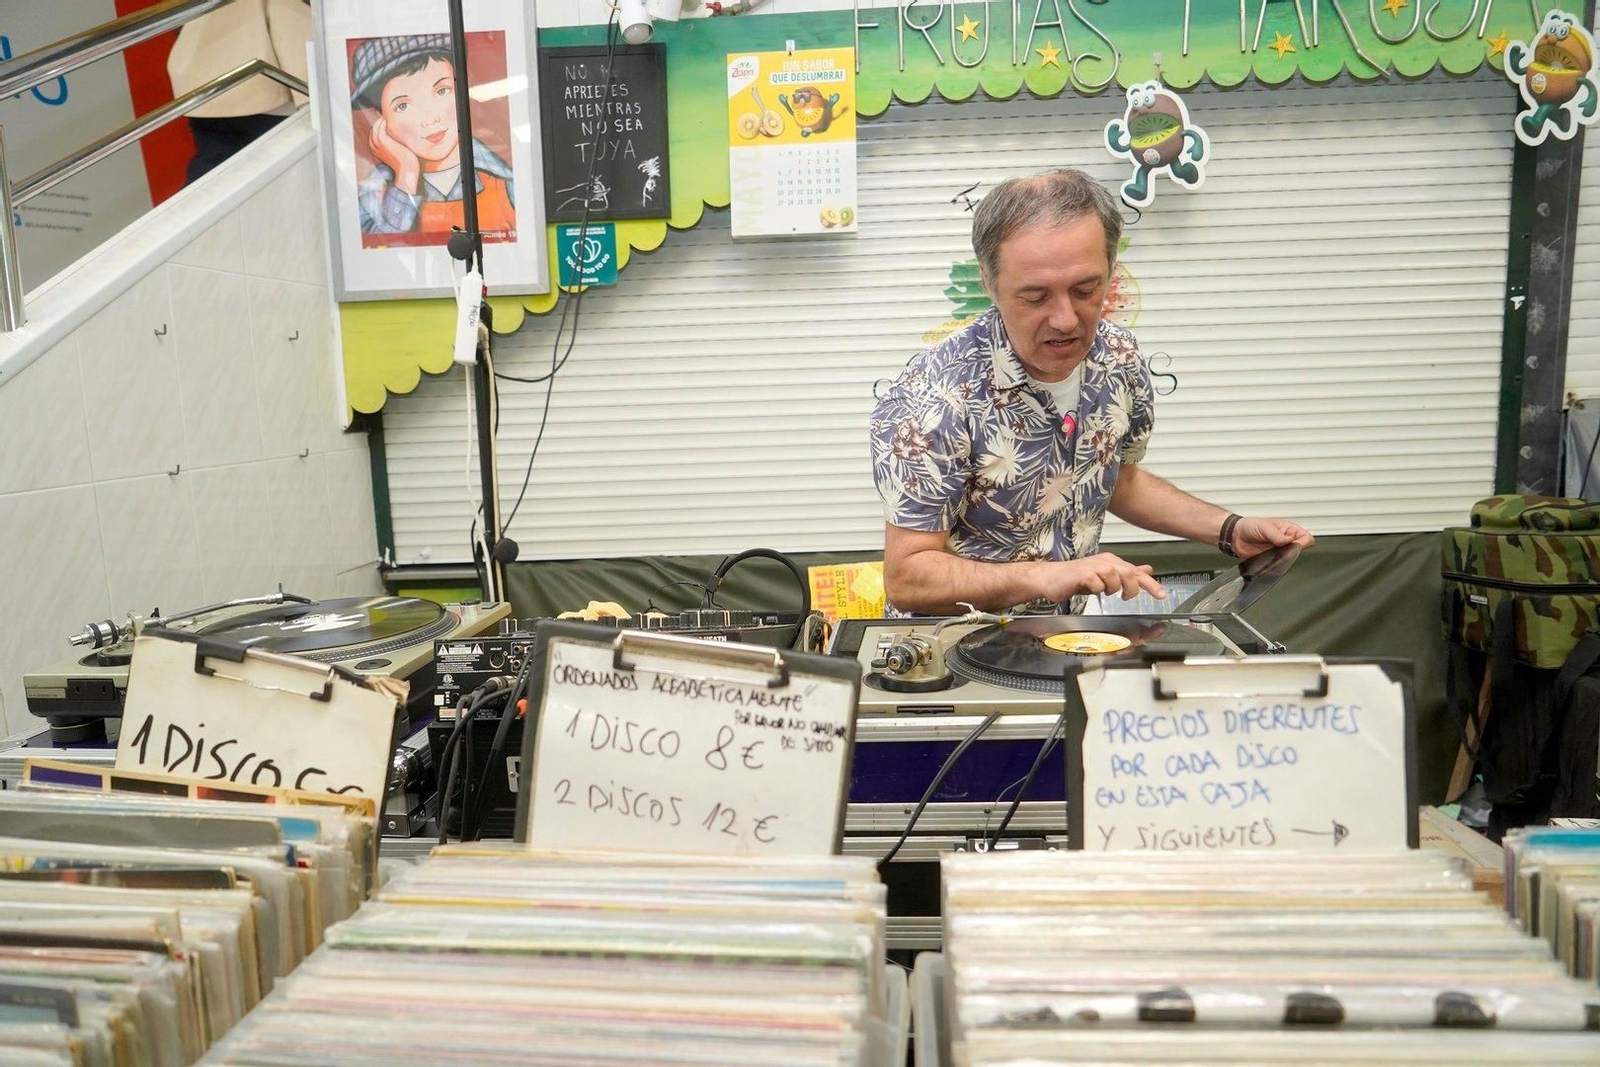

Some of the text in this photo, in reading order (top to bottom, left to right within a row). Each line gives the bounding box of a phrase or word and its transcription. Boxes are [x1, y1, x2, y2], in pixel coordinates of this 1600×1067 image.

[565, 64, 587, 81] NO
[731, 68, 755, 78] Zespri
[804, 59, 835, 70] SABOR
[772, 71, 843, 83] QUE DESLUMBRA!
[566, 102, 642, 119] MIENTRAS
[581, 119, 643, 136] NO SEA
[835, 570, 848, 607] STYLE
[566, 709, 581, 738] 1
[788, 718, 806, 730] NO
[131, 714, 154, 764] 1
[1110, 753, 1146, 778] POR
[1164, 752, 1221, 777] CADA
[1095, 779, 1273, 808] EN ESTA CAJA
[553, 778, 576, 805] 2
[702, 802, 738, 836] 12
[1098, 825, 1115, 851] Y
